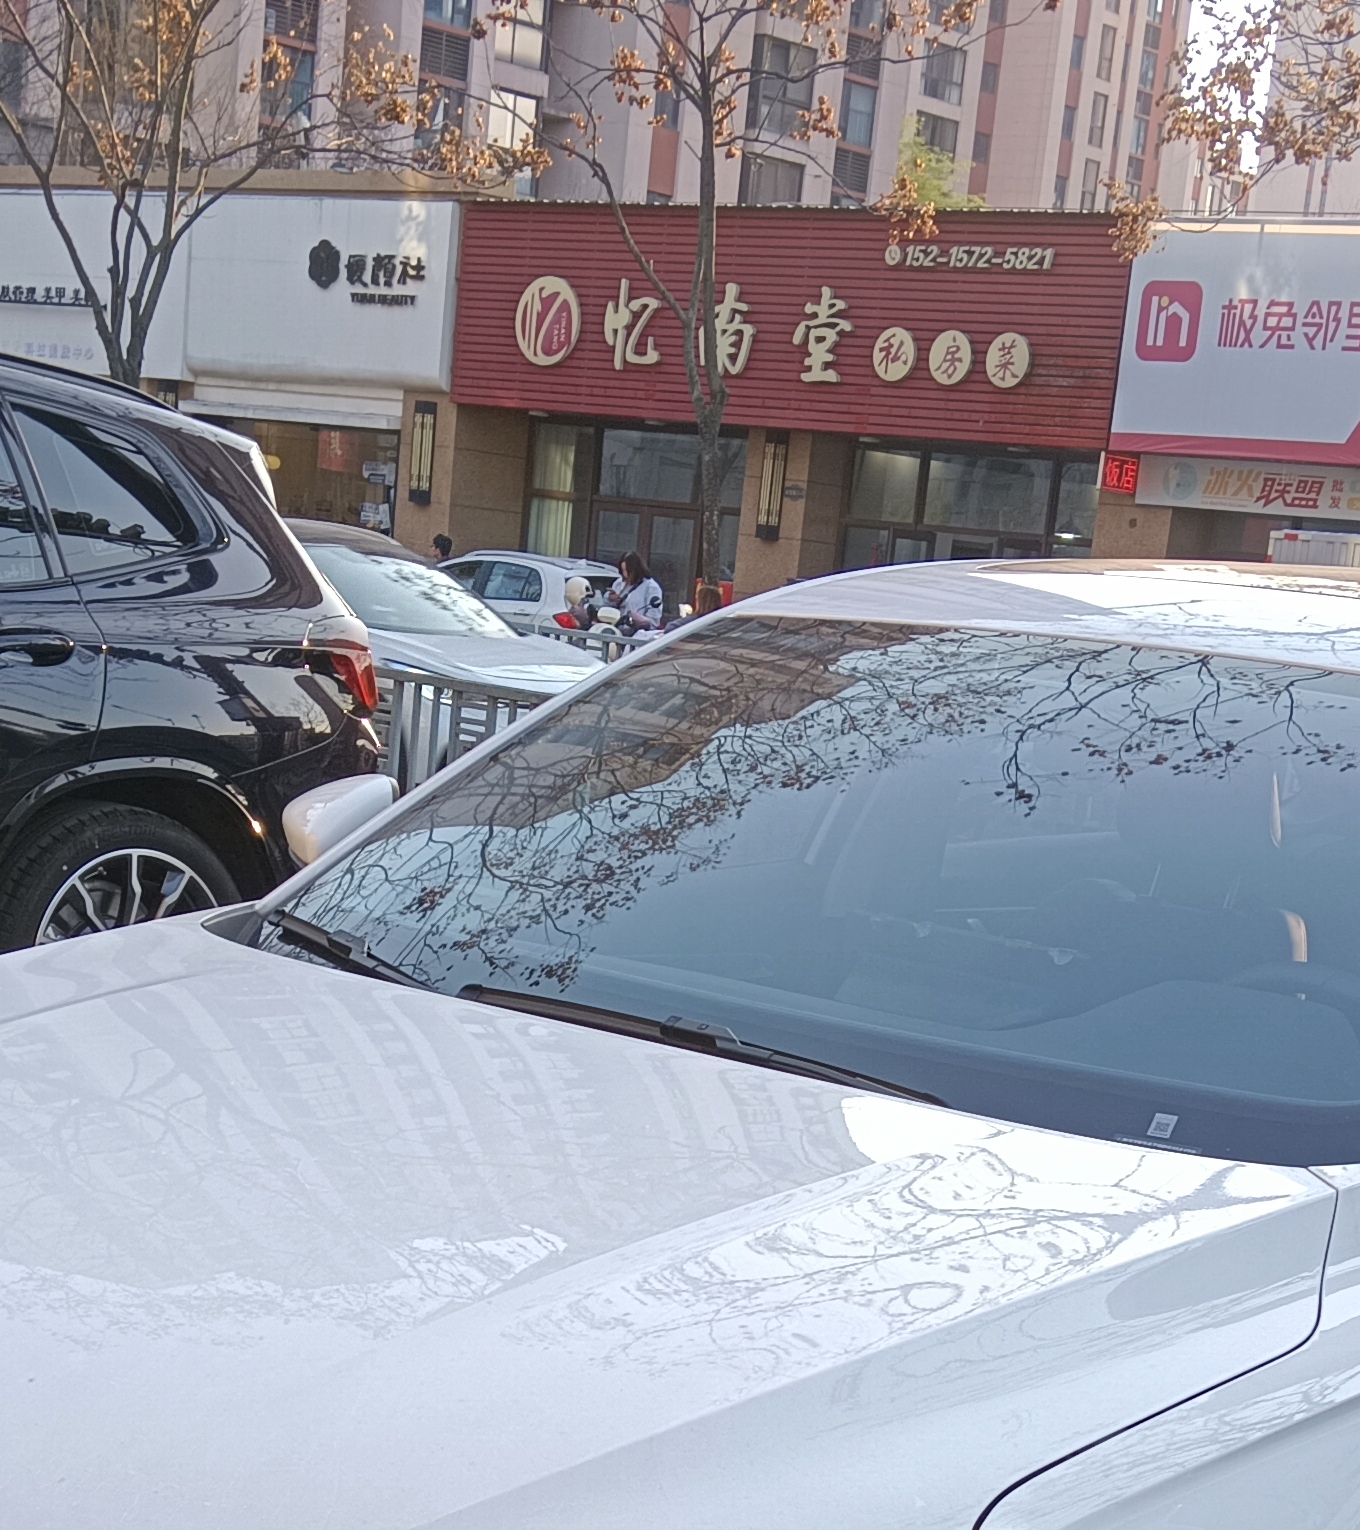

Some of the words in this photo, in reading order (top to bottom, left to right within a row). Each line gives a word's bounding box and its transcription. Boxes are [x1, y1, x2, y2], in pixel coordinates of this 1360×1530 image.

[905, 246, 1054, 270] 152-1572-5821
[877, 332, 1021, 382] 私房菜
